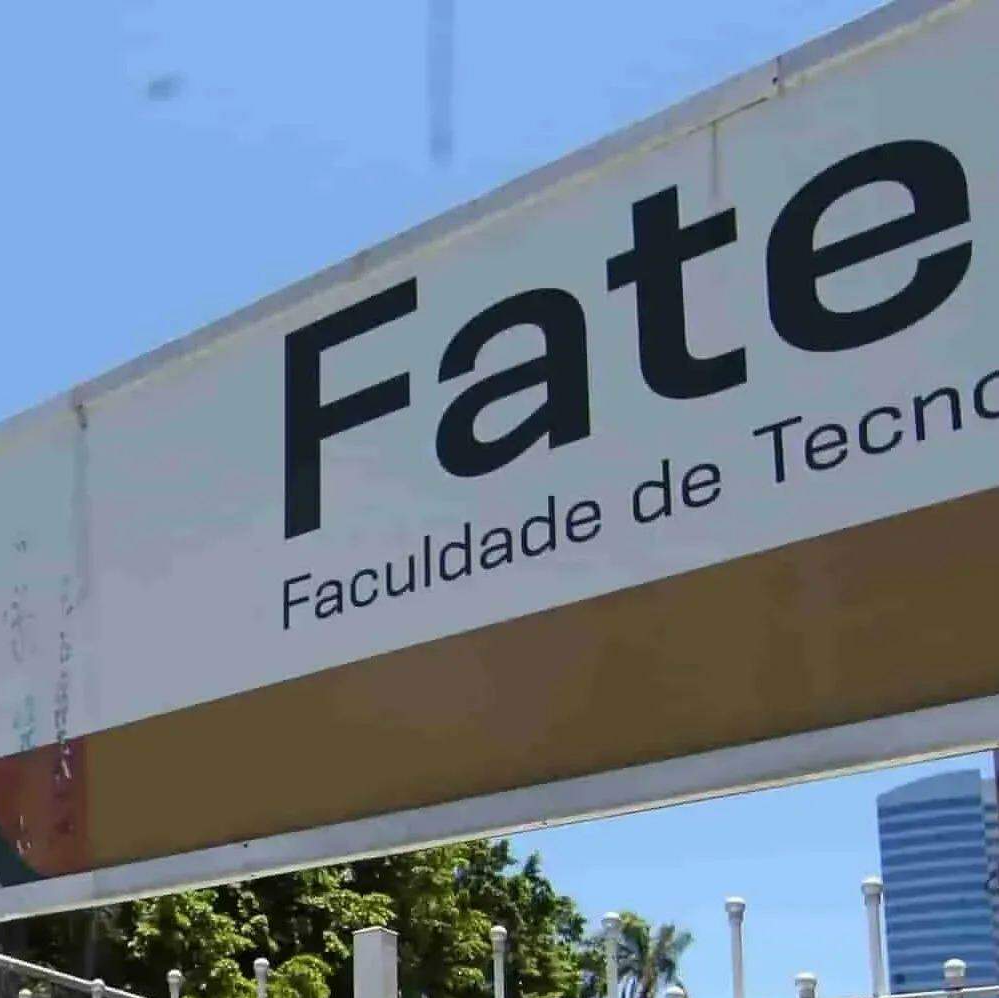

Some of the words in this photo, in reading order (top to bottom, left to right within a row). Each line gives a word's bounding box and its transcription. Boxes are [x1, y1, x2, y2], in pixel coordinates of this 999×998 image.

[284, 139, 973, 540] Fate
[282, 495, 601, 630] Faculdade
[632, 458, 721, 523] de
